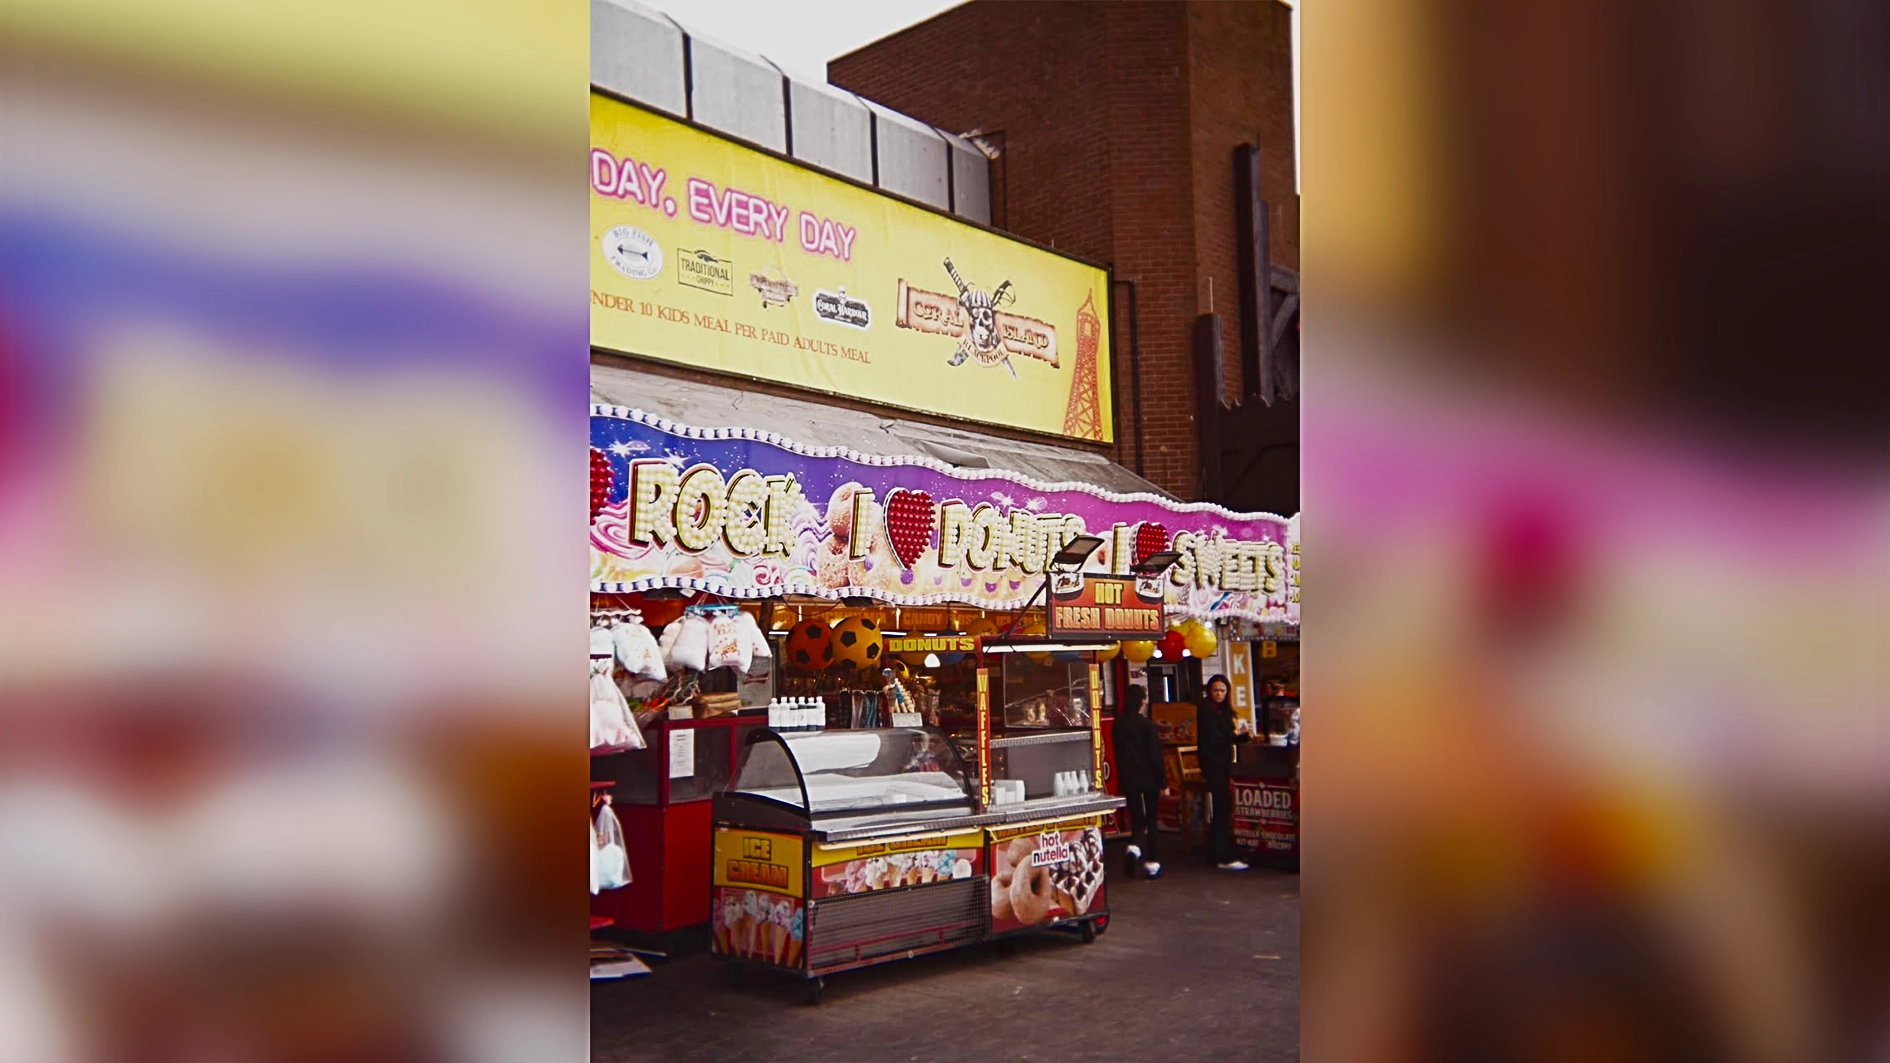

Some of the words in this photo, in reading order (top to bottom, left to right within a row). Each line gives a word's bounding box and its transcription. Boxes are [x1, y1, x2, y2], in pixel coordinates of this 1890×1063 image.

[688, 177, 789, 242] EVERY
[799, 211, 856, 261] DAY
[612, 228, 630, 238] BIG
[611, 255, 647, 277] TRADING
[681, 258, 731, 280] TRADITIONAL
[696, 276, 714, 287] CHIPPY
[590, 289, 635, 312] NDER
[640, 302, 653, 316] 10
[657, 305, 690, 324] KIDS
[694, 313, 731, 333] MEAL
[735, 322, 757, 339] PER
[761, 328, 789, 346] PAID
[793, 336, 838, 356] ADULTS
[840, 346, 871, 364] MEAL
[913, 300, 964, 328] CORAL
[1002, 323, 1049, 349] ISLAND
[629, 458, 804, 559] ROCK
[849, 487, 876, 561] I
[1111, 522, 1131, 575] I
[1170, 529, 1285, 593] SWEETS
[1095, 582, 1123, 605] HOT
[902, 612, 943, 625] CANDY
[1055, 606, 1101, 631] FRESH
[1104, 607, 1159, 632] DONUTS
[889, 637, 975, 652] DONUTS
[977, 674, 990, 806] WAFFLES
[1091, 670, 1103, 790] DONUTS
[1235, 788, 1292, 809] LOADED
[1235, 806, 1293, 819] STRAWBERRIES
[743, 836, 771, 861] ICE
[1042, 833, 1059, 848] hot
[1033, 846, 1068, 864] nutella
[727, 860, 789, 890] CREAM
